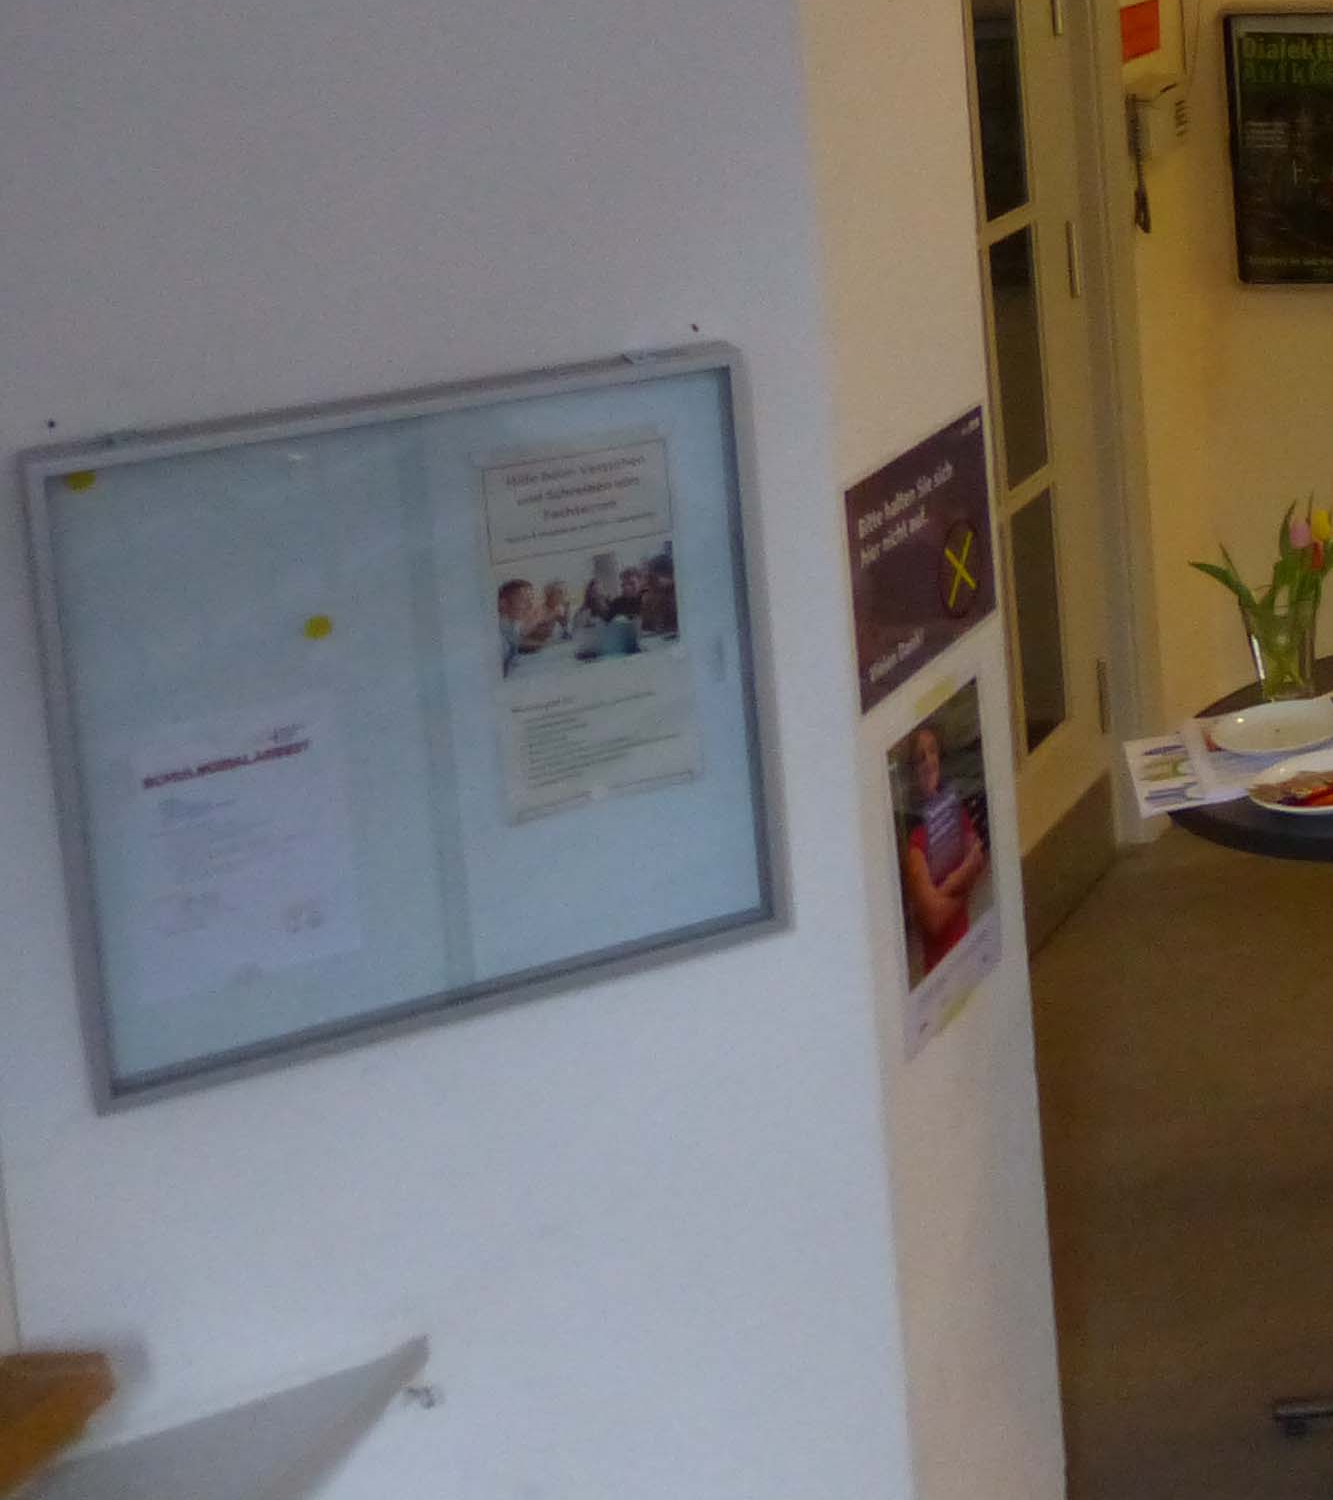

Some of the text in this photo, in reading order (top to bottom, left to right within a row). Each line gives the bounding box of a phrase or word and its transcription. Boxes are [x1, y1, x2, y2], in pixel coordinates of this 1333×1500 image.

[858, 460, 953, 539] Bitte halten Sie sich
[882, 519, 908, 551] nicht
